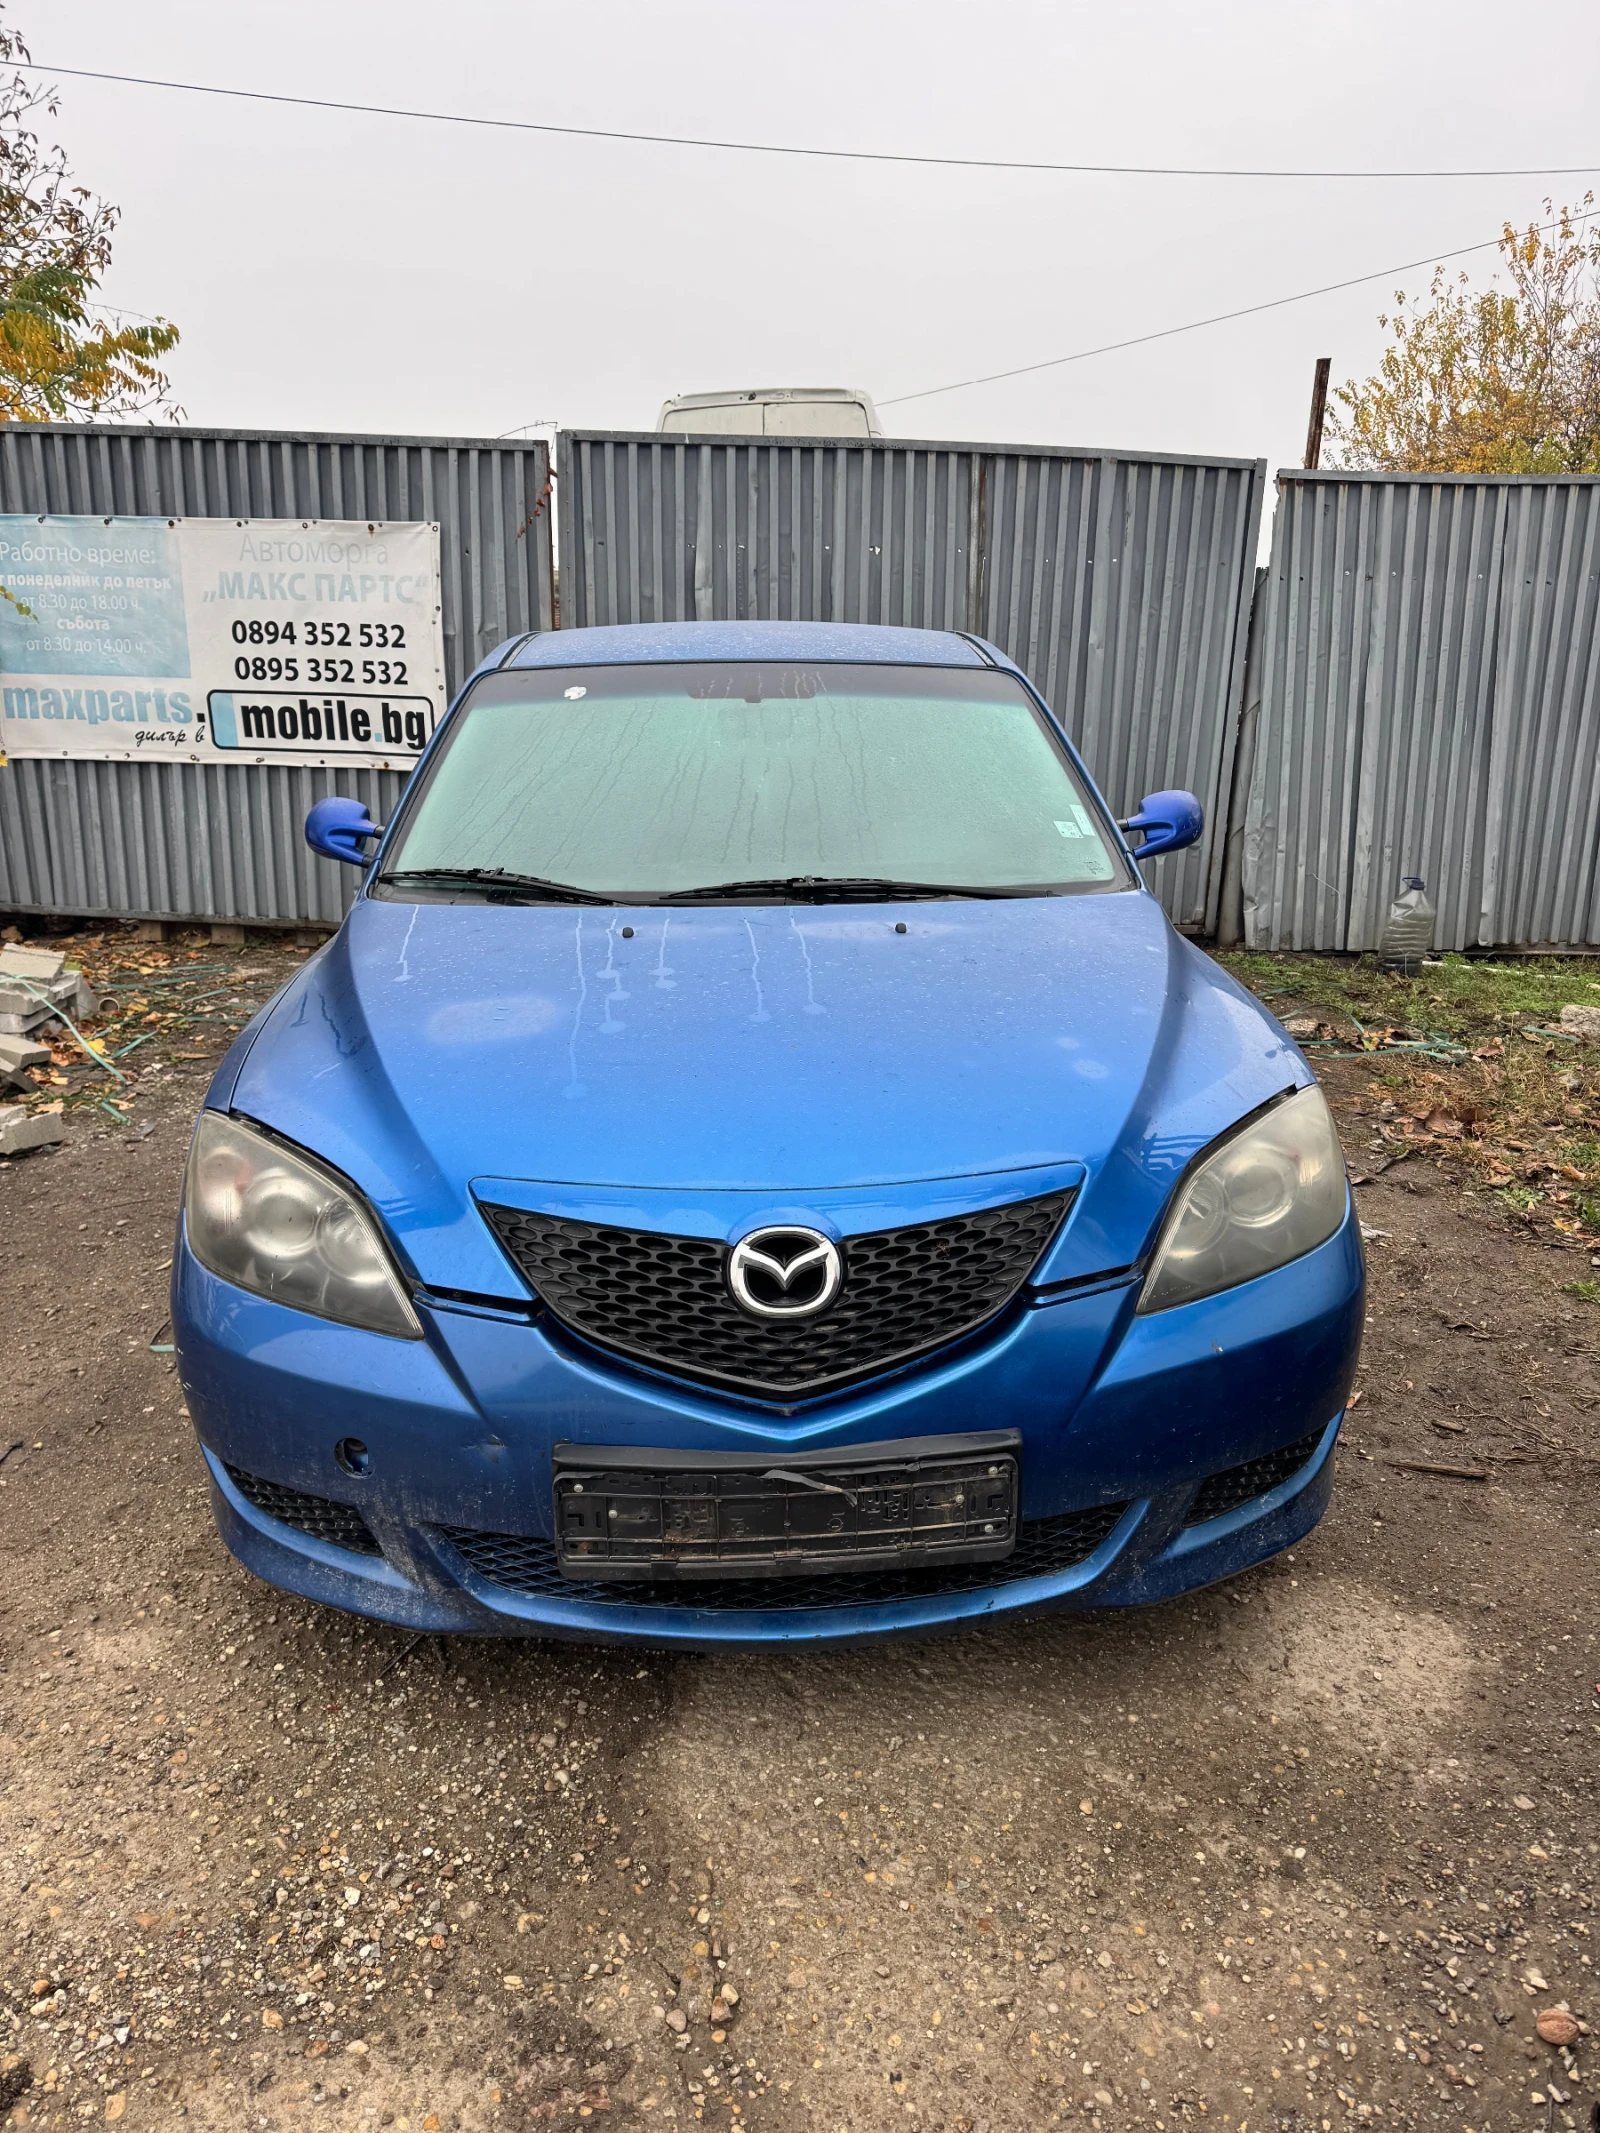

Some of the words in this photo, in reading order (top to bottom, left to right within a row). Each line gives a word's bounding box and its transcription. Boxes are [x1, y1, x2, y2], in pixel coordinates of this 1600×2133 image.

[0, 541, 82, 563] Работно
[87, 547, 156, 568] време:
[239, 533, 389, 571] Автоморга
[7, 574, 100, 590] понеделник
[103, 576, 122, 591] до
[126, 576, 172, 590] петък
[38, 593, 67, 609] 8.30
[70, 597, 87, 611] до
[91, 595, 127, 610] 18.00
[57, 615, 110, 631] събота
[231, 619, 297, 645] 0894
[303, 621, 352, 647] 352
[359, 623, 406, 649] 532
[26, 639, 40, 651] от
[43, 636, 71, 651] 8.30
[74, 640, 92, 654] до
[96, 638, 131, 653] 14.00
[234, 656, 299, 682] 0895
[306, 657, 355, 683] 352
[362, 660, 408, 685] 532
[240, 698, 427, 750] mobile.bg
